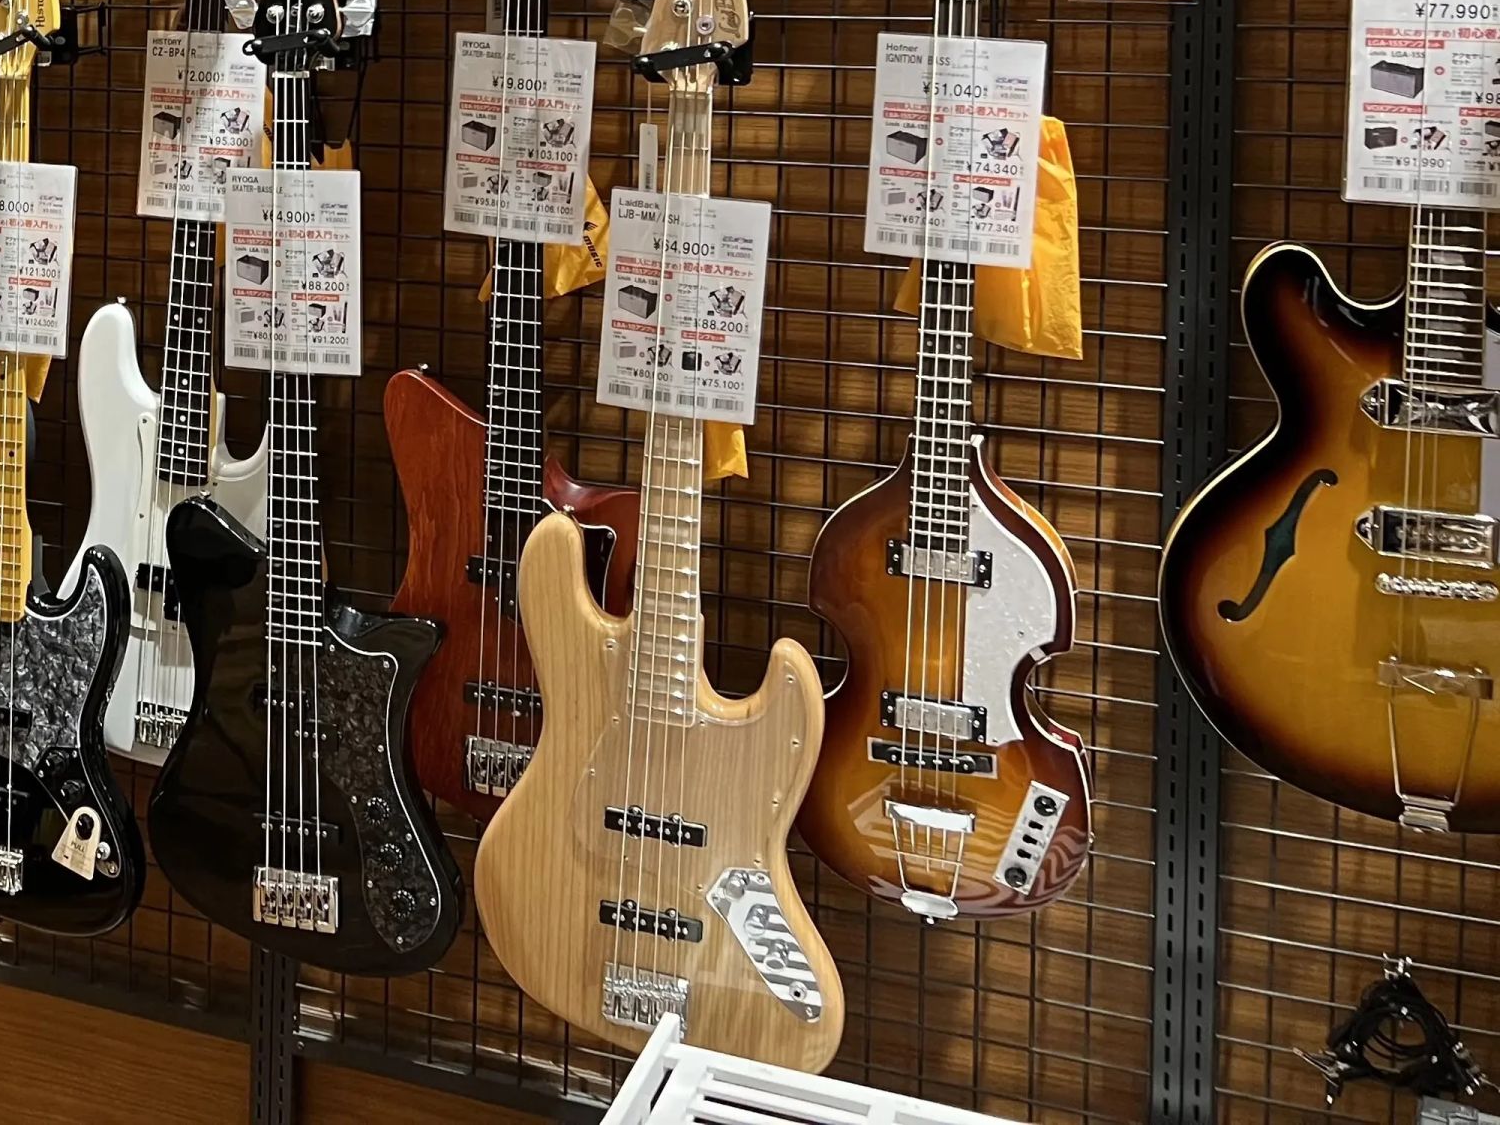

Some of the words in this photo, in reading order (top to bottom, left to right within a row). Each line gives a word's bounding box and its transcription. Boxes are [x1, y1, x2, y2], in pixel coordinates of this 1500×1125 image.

[1415, 3, 1491, 19] ¥77,990
[152, 38, 182, 46] HISTORY
[462, 41, 491, 50] RYOGA
[885, 42, 919, 53] Hofner
[152, 47, 197, 59] CZ-BP4R
[885, 53, 923, 65] IGNITION
[491, 76, 542, 91] ¥79,800
[922, 81, 982, 99] ¥51,040
[209, 135, 249, 147] ¥95,300
[966, 159, 1018, 176] ¥74,340
[1395, 156, 1446, 169] ¥91990
[231, 175, 259, 184] RYOGA
[231, 185, 283, 195] SKATER-BASSLE
[475, 197, 506, 209] ¥95,80
[619, 197, 660, 210] LaidBack
[902, 216, 941, 227] ¥67040
[301, 280, 345, 292] ¥88,200
[694, 318, 743, 334] ¥88,200
[253, 332, 283, 342] ¥80,00
[632, 368, 669, 383] ¥80,00
[701, 378, 741, 391] ¥75,100
